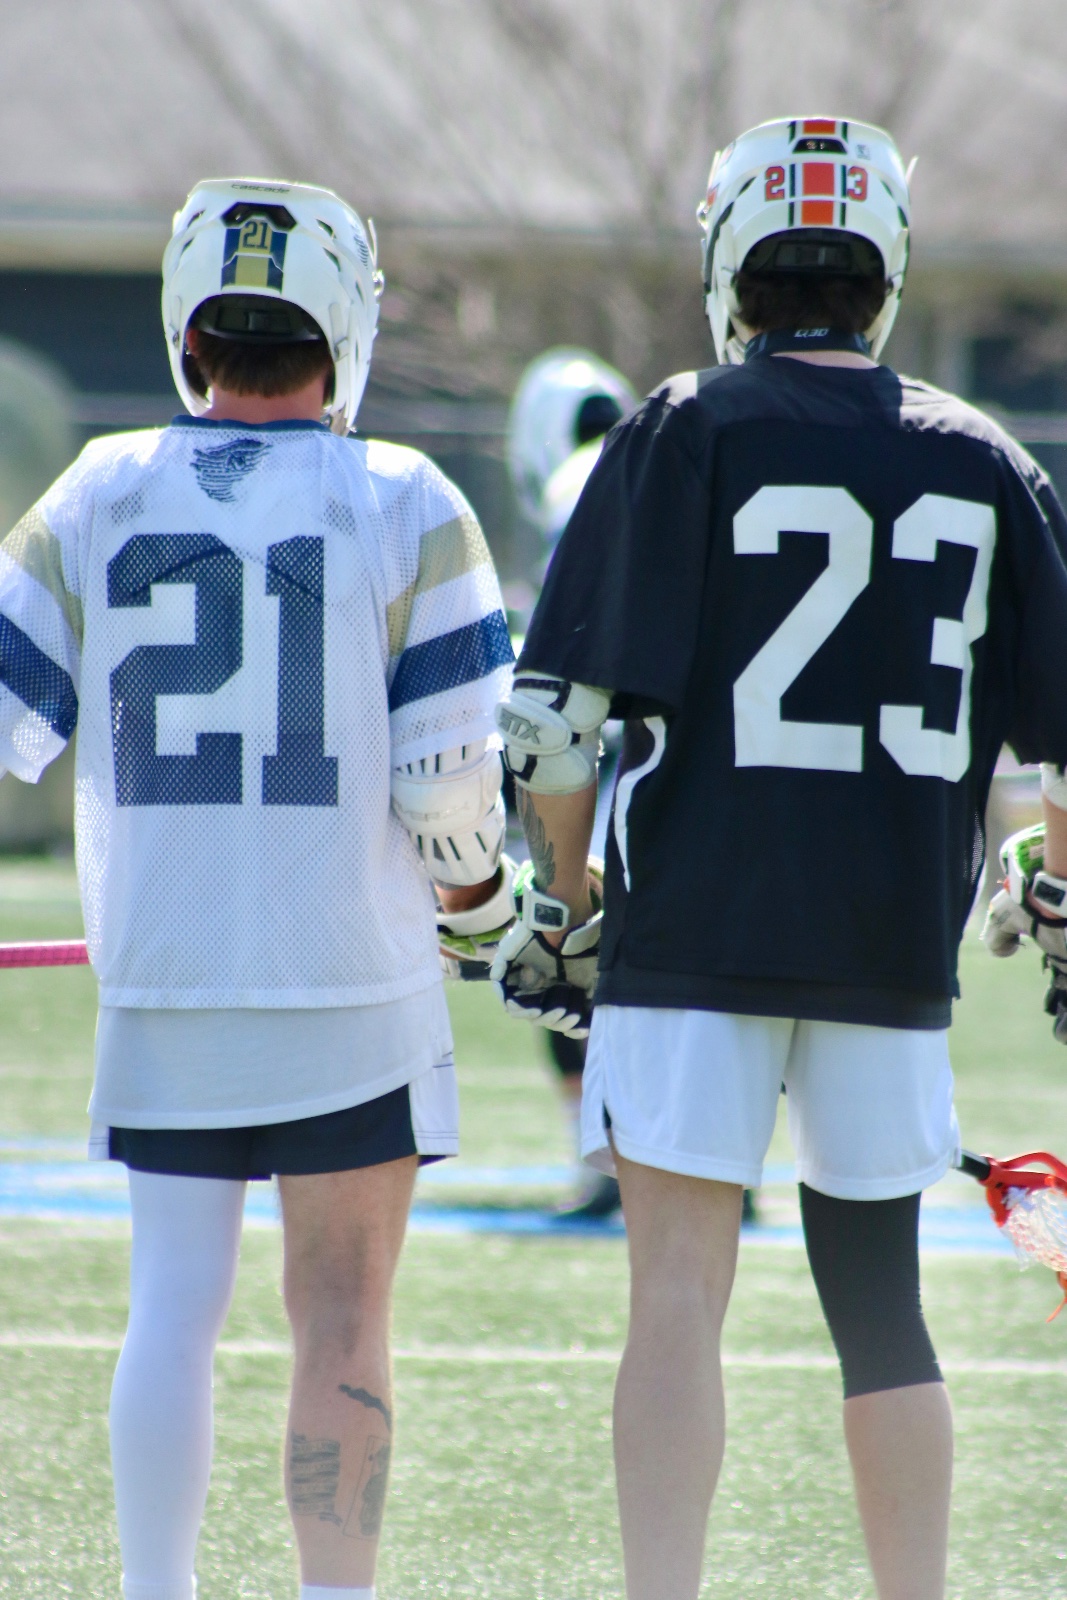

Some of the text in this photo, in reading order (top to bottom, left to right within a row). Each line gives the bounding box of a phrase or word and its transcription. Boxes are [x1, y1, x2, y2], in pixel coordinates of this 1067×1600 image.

[231, 183, 290, 194] cascade
[242, 221, 268, 249] 21
[733, 485, 996, 783] 23
[107, 533, 339, 807] 21
[499, 708, 541, 744] STX
